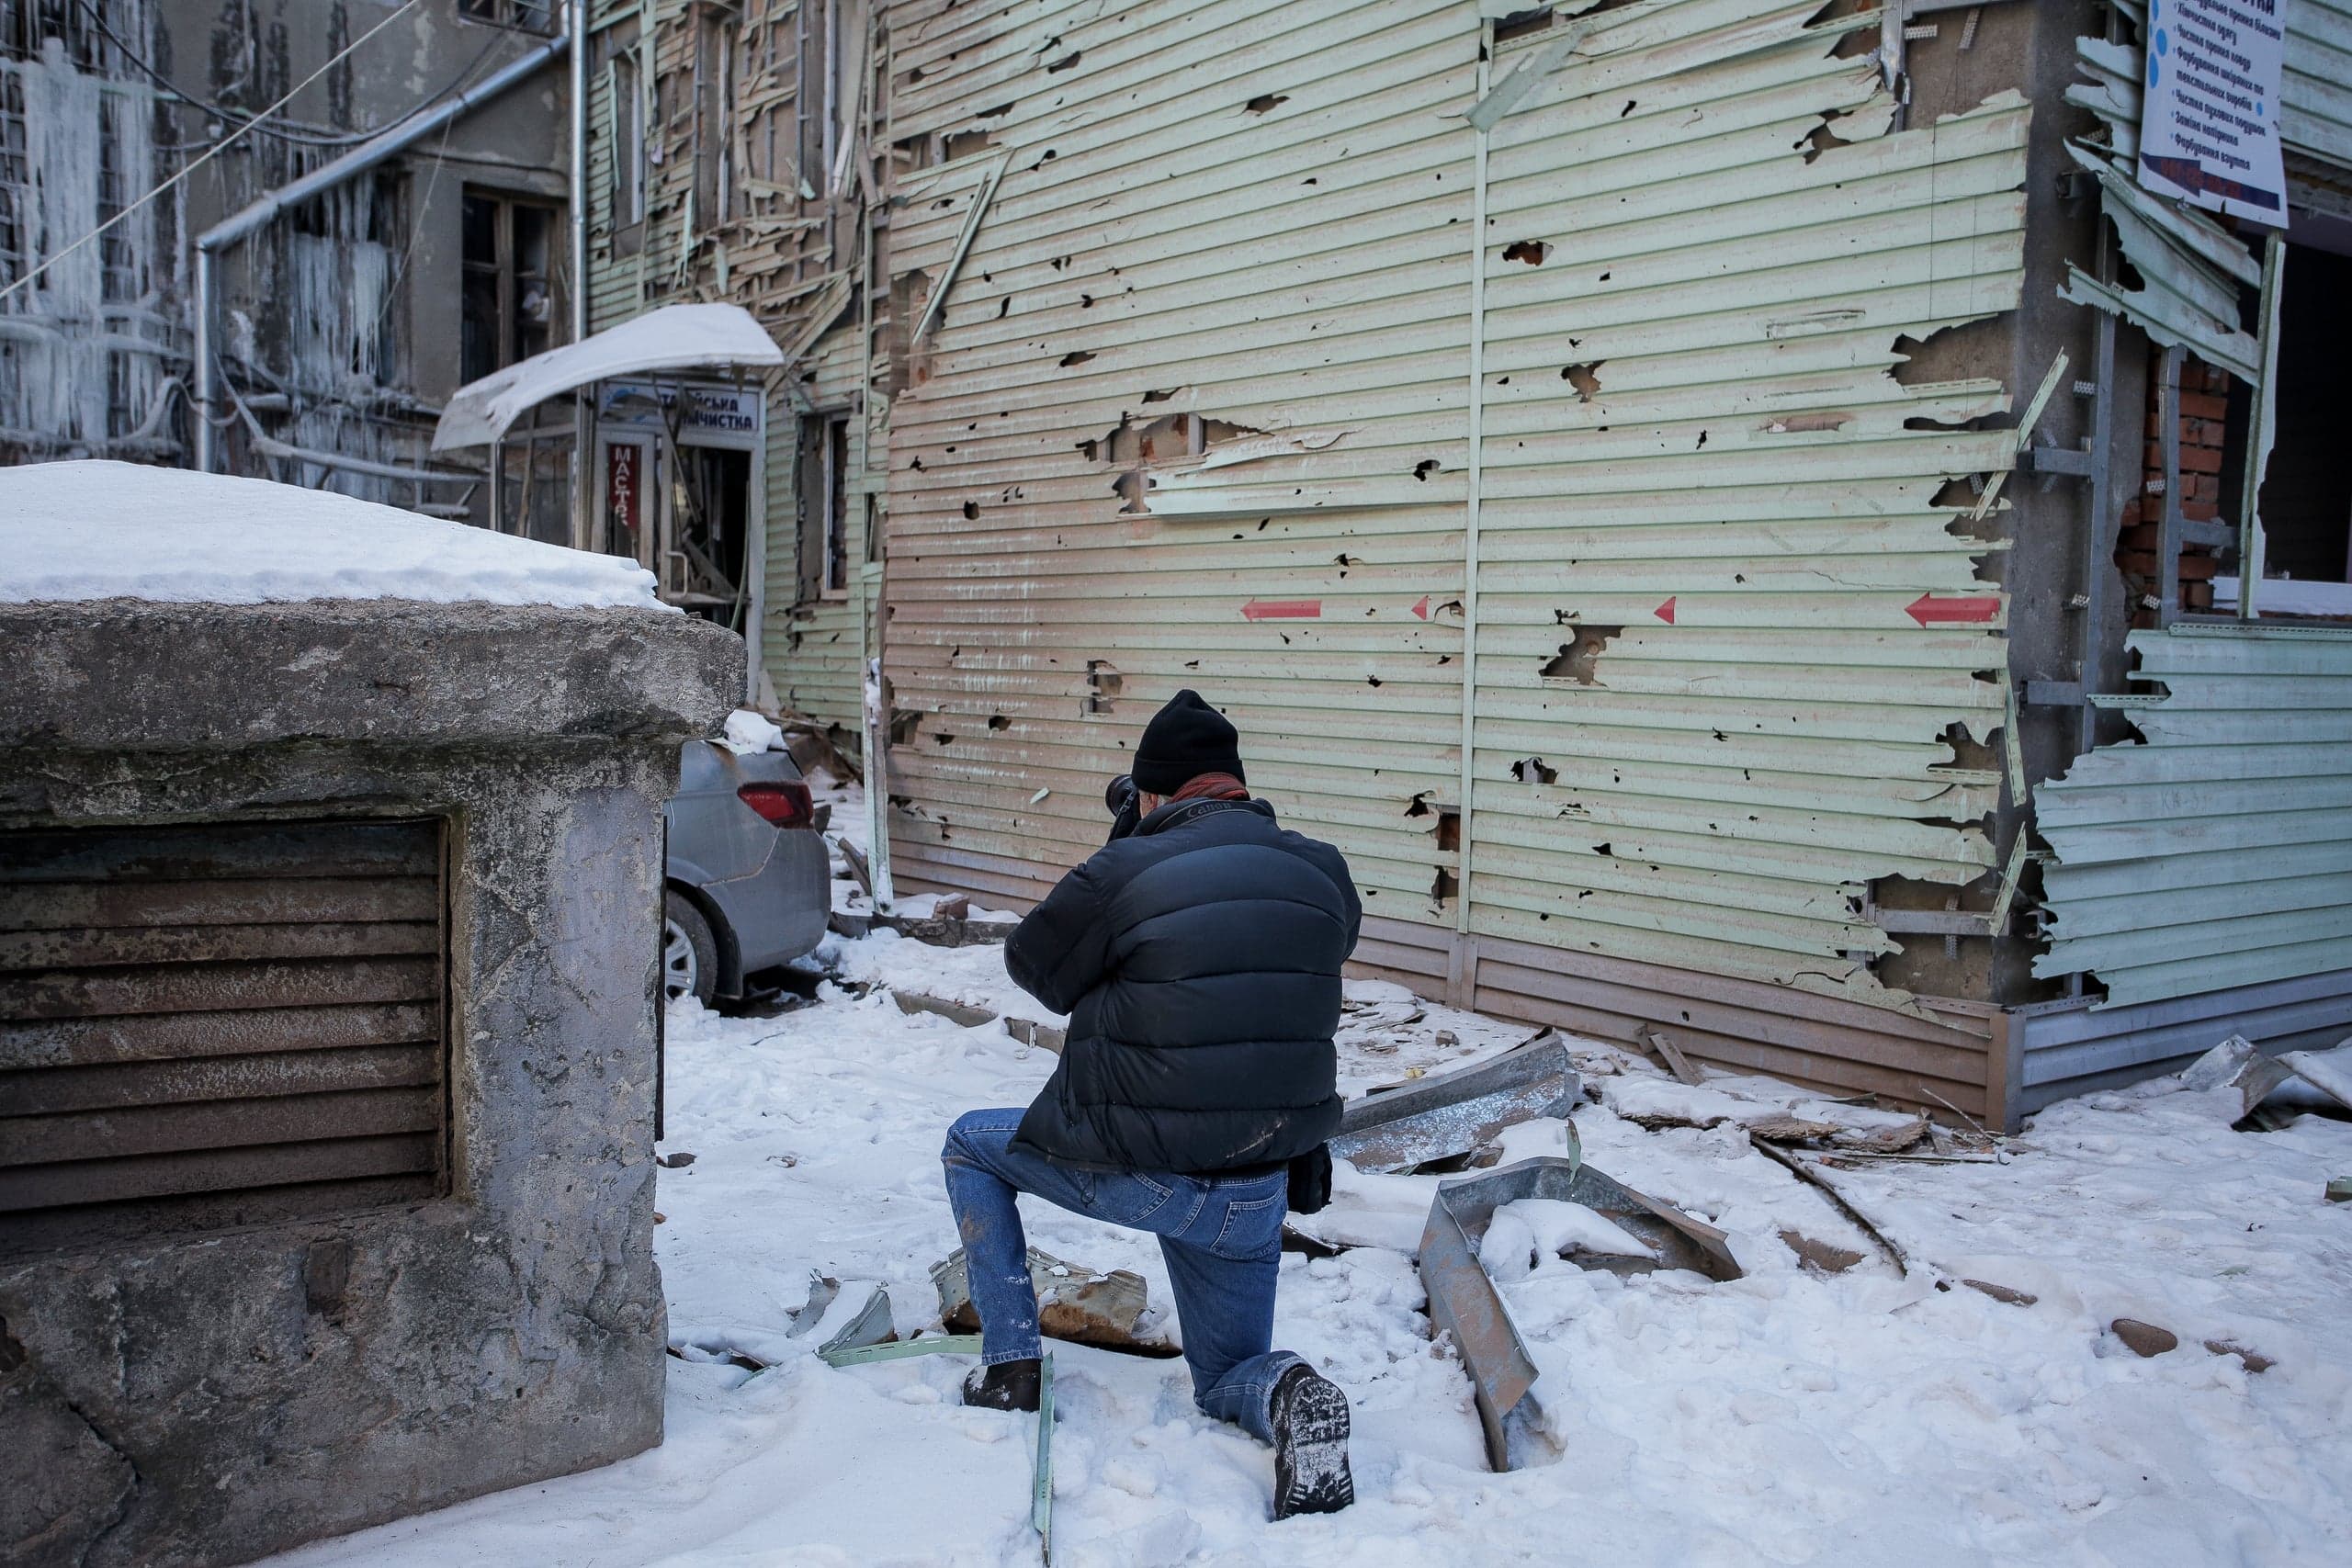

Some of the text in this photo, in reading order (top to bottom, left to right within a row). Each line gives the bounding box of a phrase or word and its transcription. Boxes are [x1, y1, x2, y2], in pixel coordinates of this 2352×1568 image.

[2177, 3, 2237, 46] Хімчистка одягу
[2177, 23, 2204, 47] Чистка
[2177, 46, 2220, 75] Фарбування
[2176, 70, 2252, 111] текстильних виробів
[2176, 88, 2203, 111] Чистка
[2175, 110, 2201, 132] Заміна
[2175, 132, 2250, 171] Фарбування взуття
[1187, 803, 1232, 818] Canon
